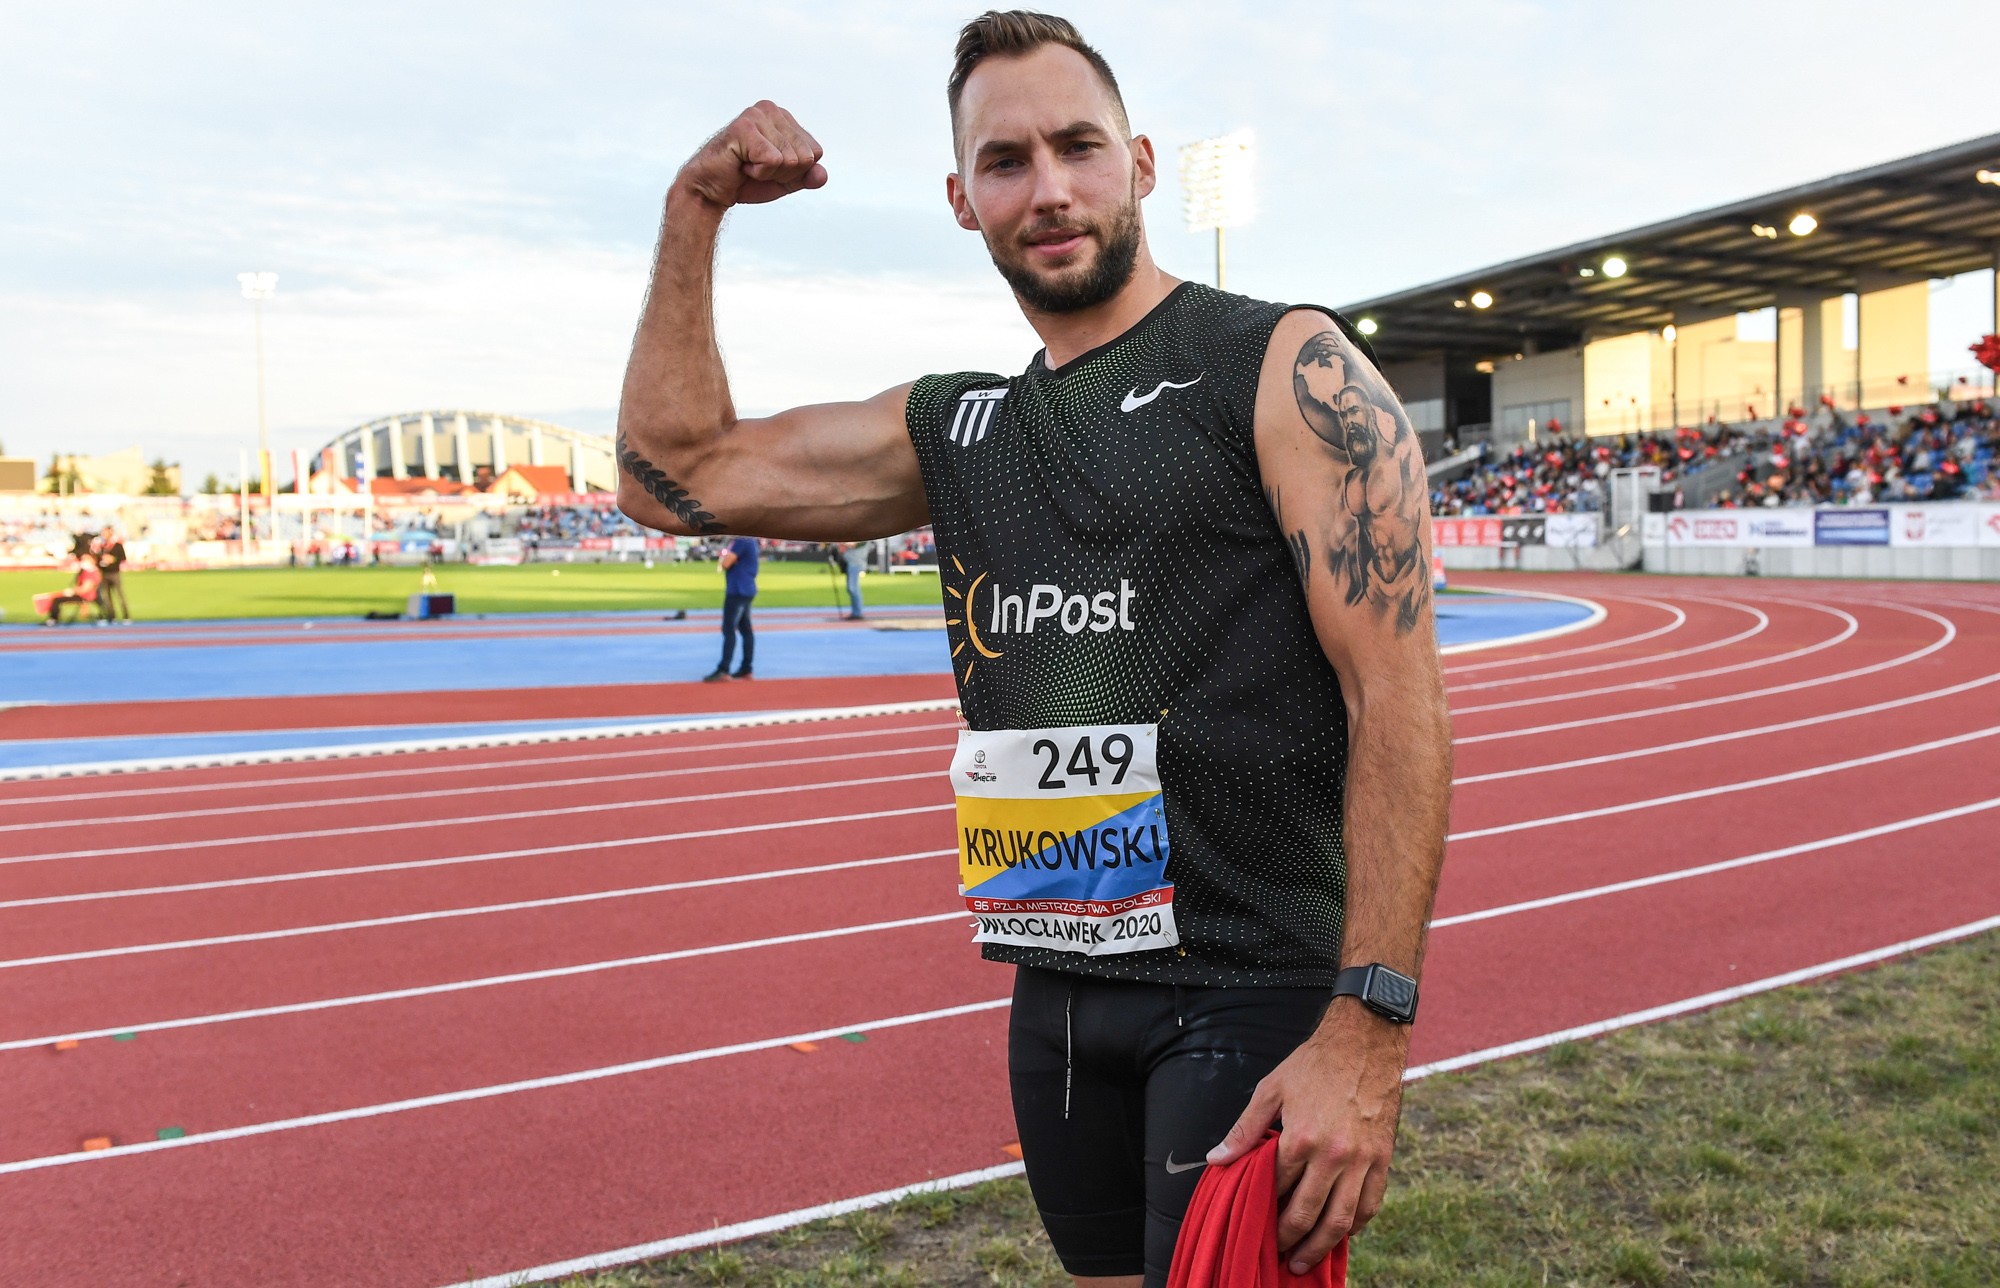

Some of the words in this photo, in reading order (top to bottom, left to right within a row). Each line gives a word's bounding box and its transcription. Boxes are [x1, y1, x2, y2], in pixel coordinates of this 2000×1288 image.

[989, 578, 1136, 634] InPost
[1032, 733, 1134, 789] 249
[964, 824, 1164, 871] KRUKOWSKI
[973, 900, 992, 911] 96.
[993, 902, 1024, 911] PZLA
[1026, 902, 1110, 914] MISTRZOSTWA
[1112, 892, 1161, 912] POLSKI
[978, 916, 1107, 945] WŁOCŁAWEK
[1112, 912, 1162, 941] 2020
